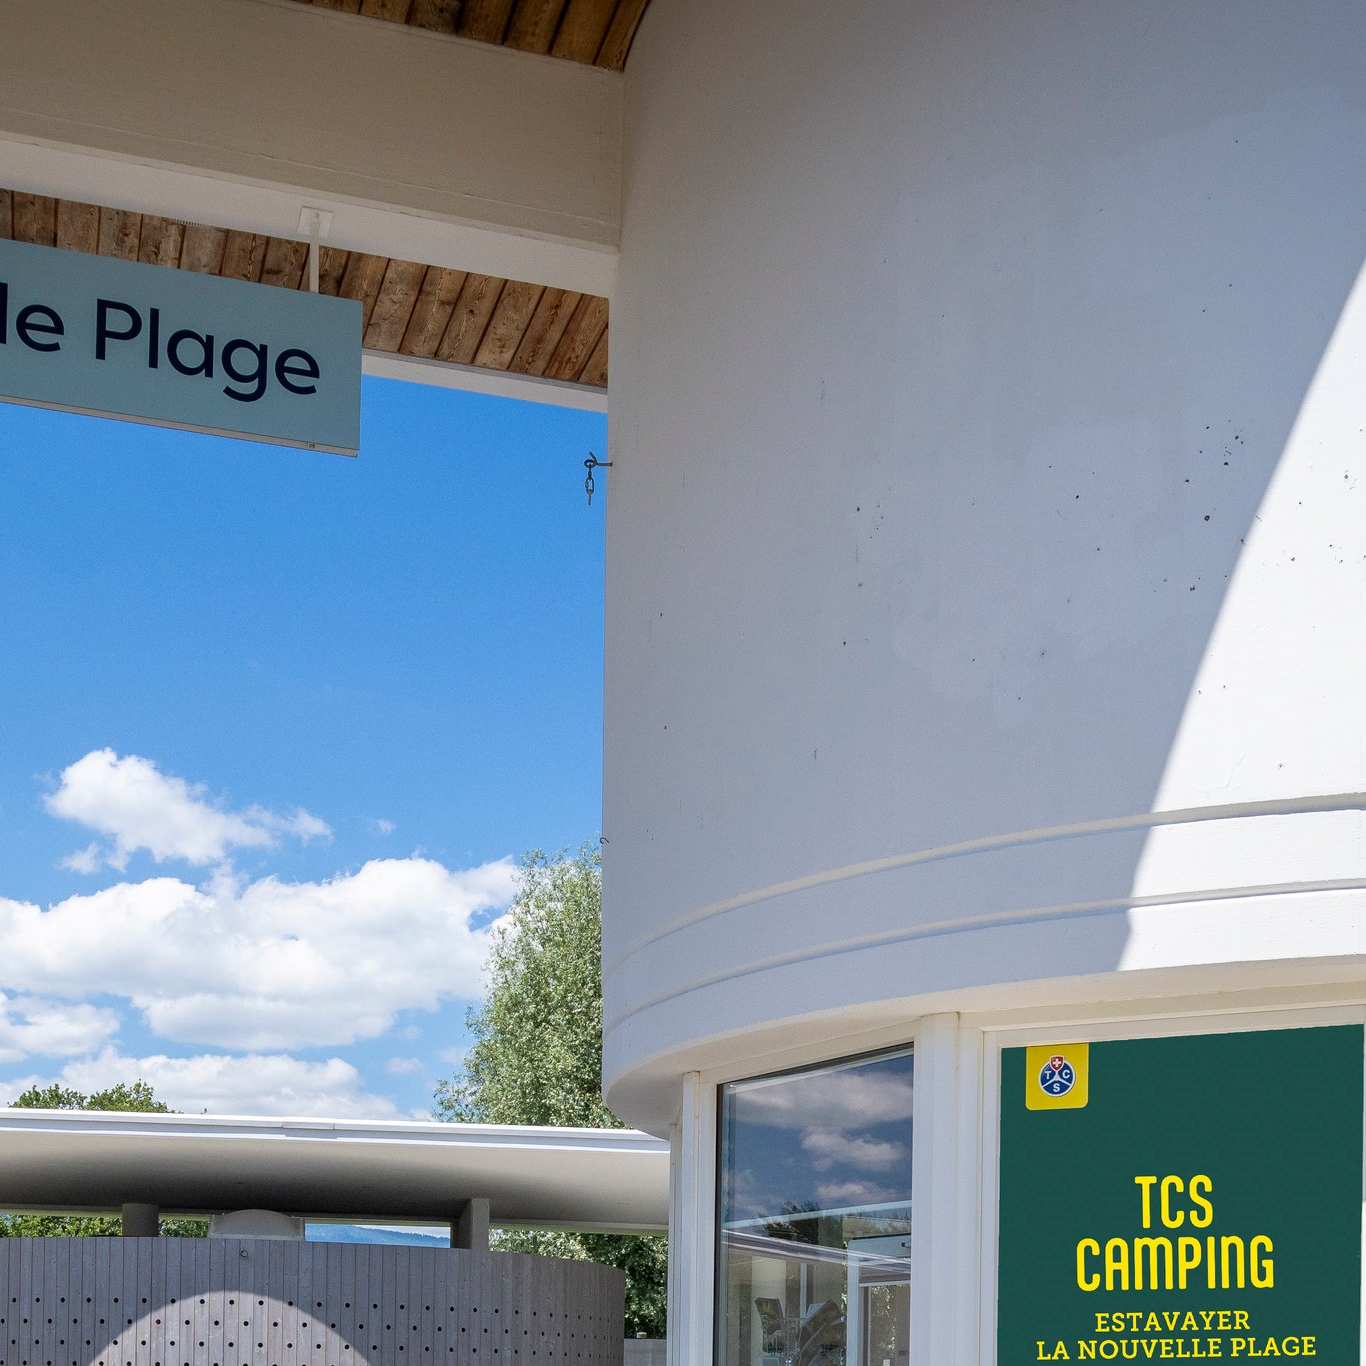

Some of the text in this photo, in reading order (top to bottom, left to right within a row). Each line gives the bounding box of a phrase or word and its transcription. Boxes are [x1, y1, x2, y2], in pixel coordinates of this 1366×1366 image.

[96, 299, 320, 403] Plage
[1134, 1175, 1214, 1229] TCS
[1076, 1235, 1274, 1291] CAMPING
[1037, 1336, 1317, 1361] LA NOUVELLE PLAGE
[1095, 1311, 1251, 1333] ESTAVAYER
